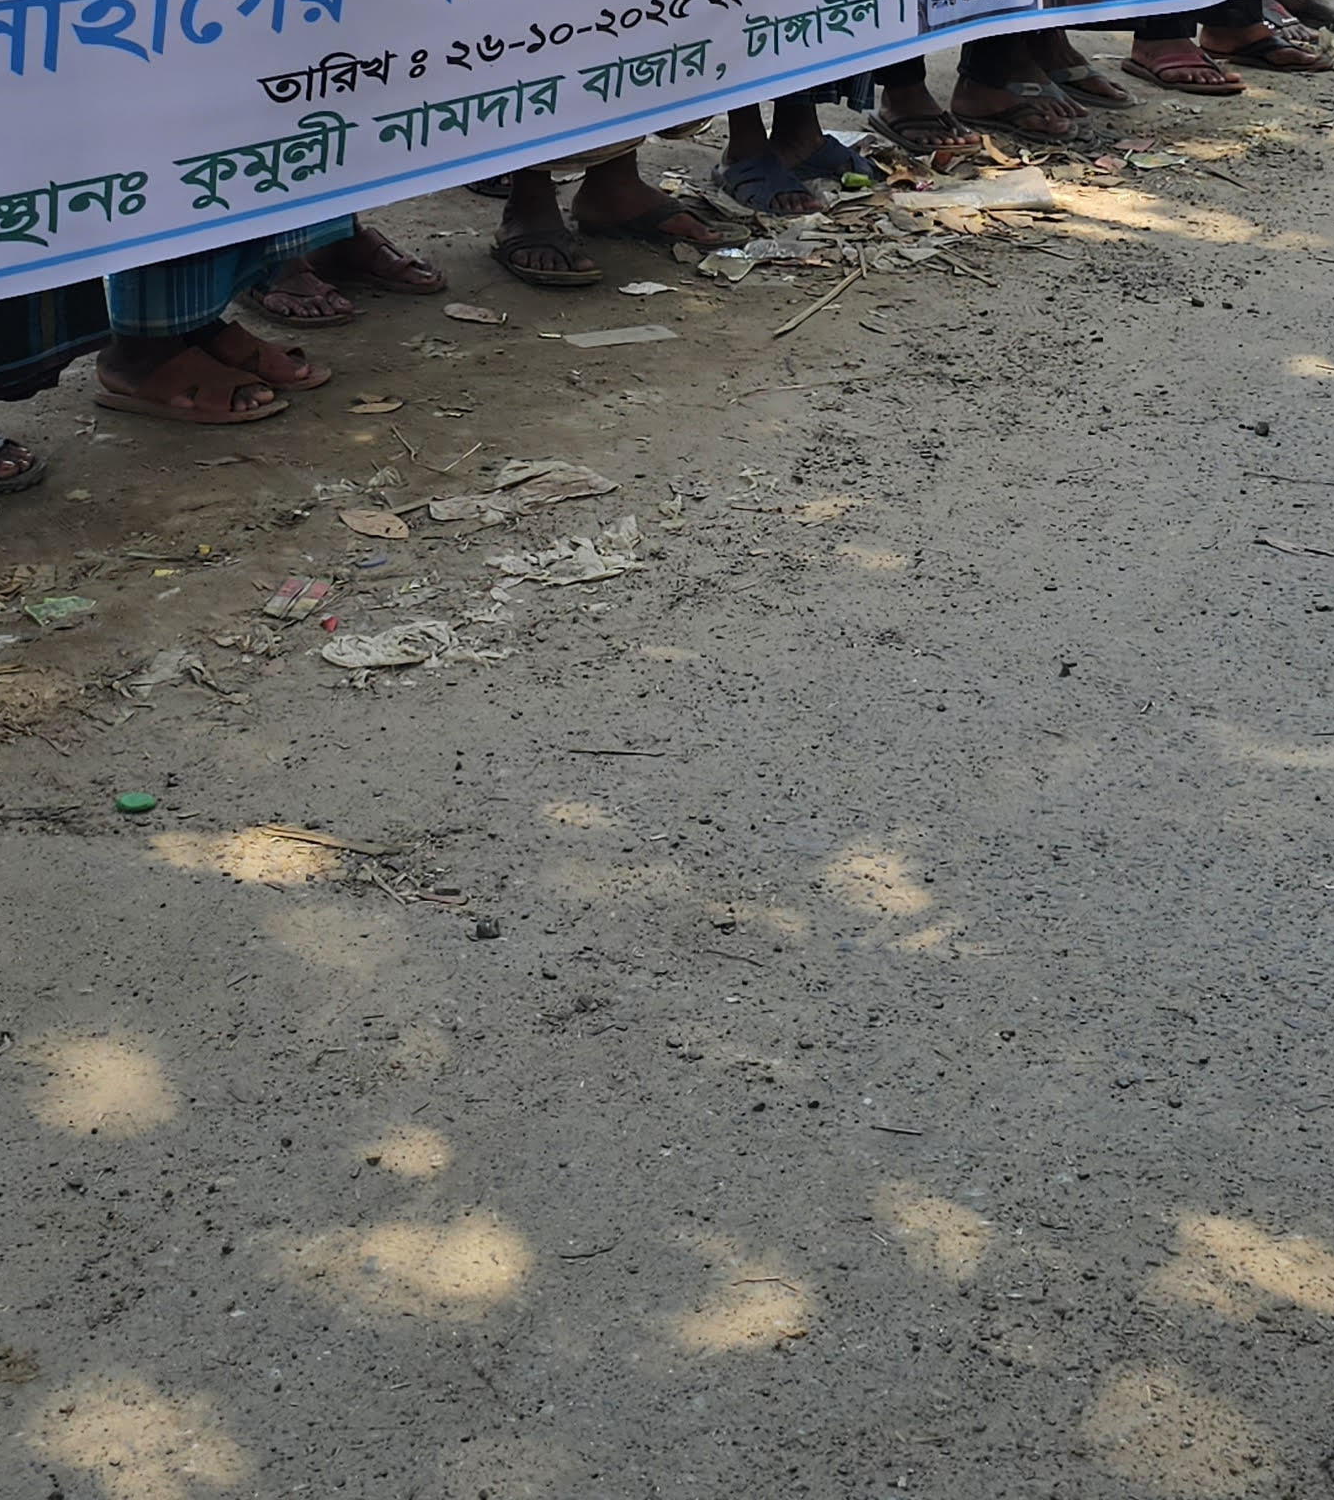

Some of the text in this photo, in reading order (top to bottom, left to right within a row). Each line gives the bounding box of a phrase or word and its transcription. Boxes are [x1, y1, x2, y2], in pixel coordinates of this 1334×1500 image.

[173, 109, 358, 211] কুমুল্লী
[371, 75, 563, 153] নামদার
[577, 38, 728, 105] বাজার,
[257, 49, 399, 104] তারিখ
